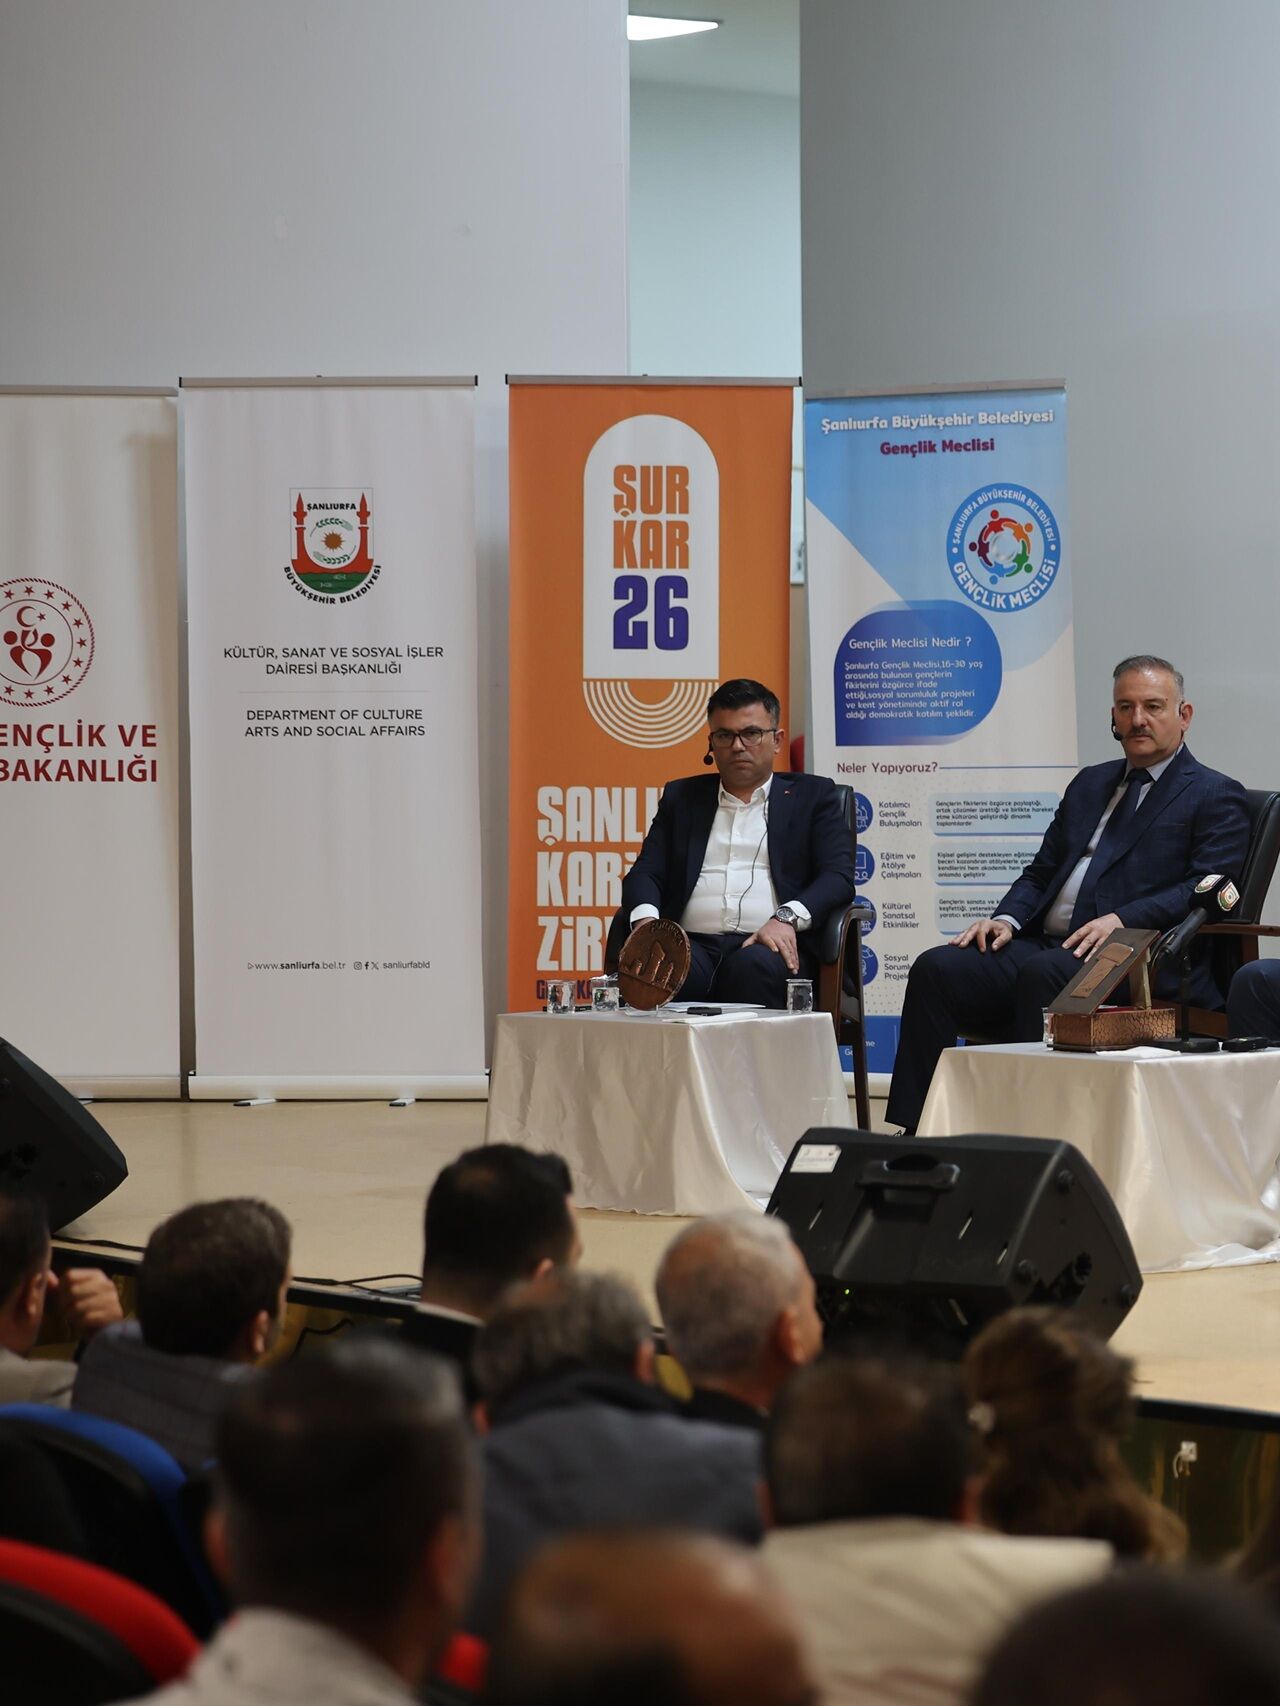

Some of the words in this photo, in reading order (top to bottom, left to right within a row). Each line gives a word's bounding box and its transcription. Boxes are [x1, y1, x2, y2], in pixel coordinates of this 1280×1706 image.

[821, 416, 888, 434] Şanlıurfa
[892, 413, 974, 431] Büyükşehir
[978, 409, 1054, 426] Belediyesi
[880, 440, 937, 458] Gençlik
[942, 438, 995, 453] Meclisi
[613, 465, 689, 518] ŞUR
[307, 503, 357, 511] ŞANLIURFA
[952, 501, 979, 544] ŞANLIURFA
[613, 520, 689, 569] KAR
[284, 566, 336, 604] BÜYÜKŞEHİR
[339, 565, 382, 604] BELEDİYESİ
[953, 561, 1007, 609] GENÇLİK
[1008, 558, 1056, 608] MECLİSİ
[613, 575, 689, 651] 26
[849, 638, 888, 651] Gençlik
[891, 637, 928, 649] Meclisi
[931, 637, 961, 648] Nedir
[224, 645, 278, 659] KÜLTÜR,
[281, 647, 326, 658] SANAT
[330, 647, 348, 658] VE
[351, 647, 403, 658] SOSYAL
[406, 645, 444, 659] İŞLER
[265, 662, 317, 675] DAİRESİ
[322, 662, 402, 676] BAŞKANLIĞI
[881, 661, 910, 670] Gençlik
[915, 671, 953, 680] gençlerin
[917, 680, 938, 688] ifade
[941, 689, 975, 699] projeleri
[858, 701, 876, 709] kent
[246, 710, 336, 720] DEPARTMENT
[340, 709, 359, 720] OF
[363, 709, 423, 720] CULTURE
[118, 724, 157, 747] VE
[244, 726, 279, 737] ARTS
[283, 726, 312, 737] AND
[316, 726, 366, 737] SOCIAL
[370, 725, 426, 736] AFFAIRS
[837, 762, 867, 773] Neler
[872, 761, 938, 775] Yapıyoruz?
[878, 801, 911, 809] Katılımcı
[879, 810, 906, 819] Gençlik
[879, 820, 922, 828] Buluşmaları
[880, 852, 904, 861] Eğitim
[881, 862, 906, 870] Atölye
[880, 871, 922, 880] Çalışmaları
[882, 902, 912, 910] Kültürel
[882, 921, 920, 929] Etkinlikler
[536, 916, 612, 971] ZİR
[884, 954, 909, 964] Sosyal
[255, 961, 346, 970] www.sanliurfa.bel.tr
[382, 961, 431, 969] sanliurfabld
